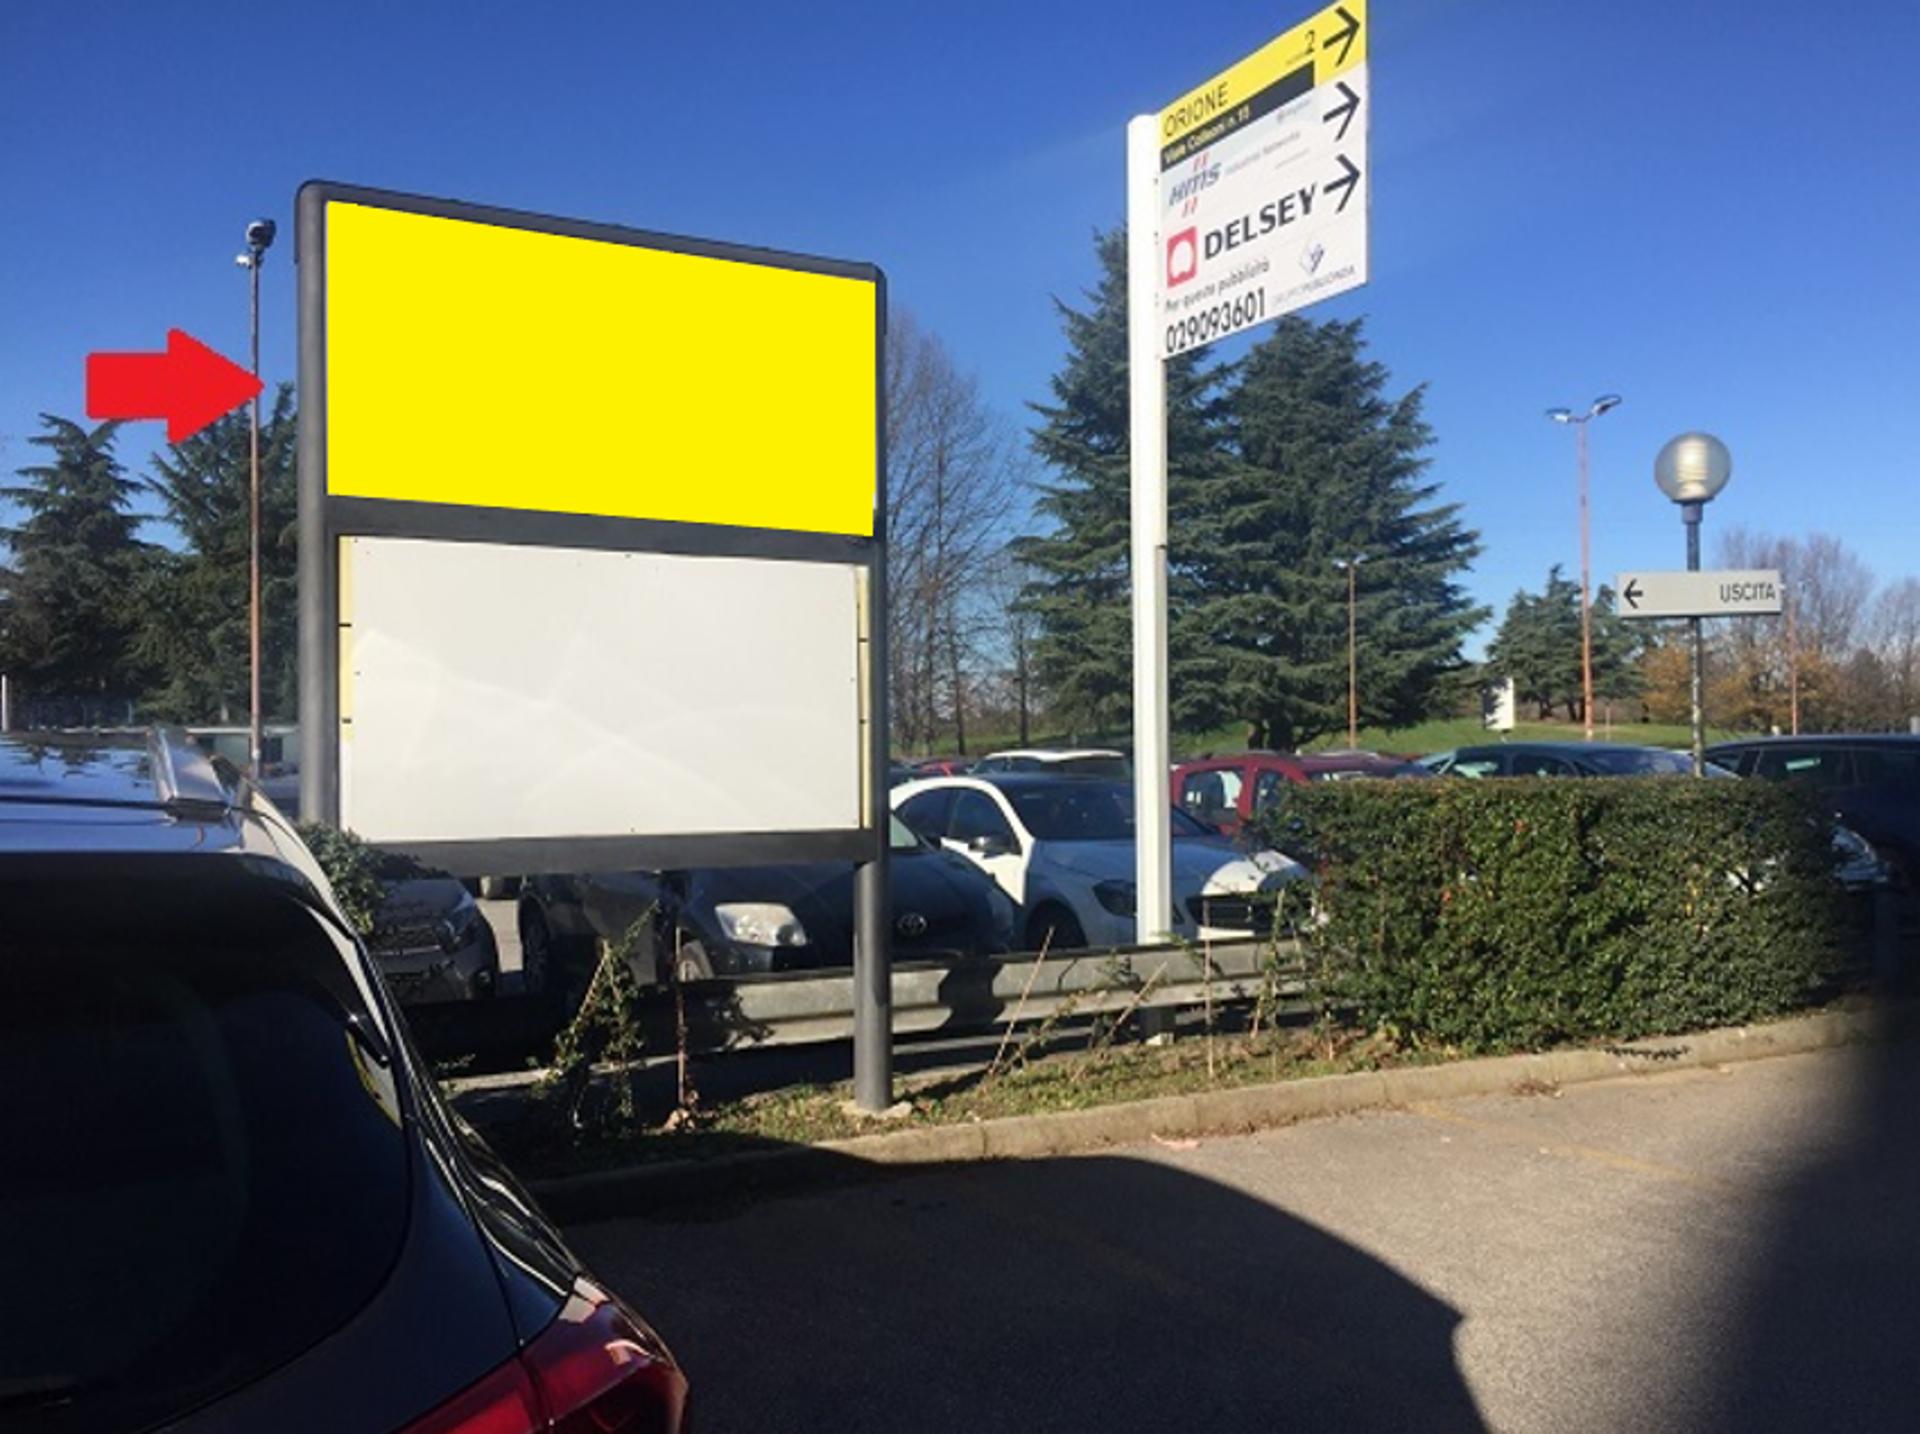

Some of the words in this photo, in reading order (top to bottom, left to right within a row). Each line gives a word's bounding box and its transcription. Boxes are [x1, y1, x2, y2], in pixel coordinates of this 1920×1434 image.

[1304, 29, 1316, 53] 2
[1163, 81, 1229, 138] ORIONE
[1204, 181, 1317, 260] DELSEY
[1165, 286, 1266, 354] 029093601
[1720, 582, 1776, 603] USCITA
